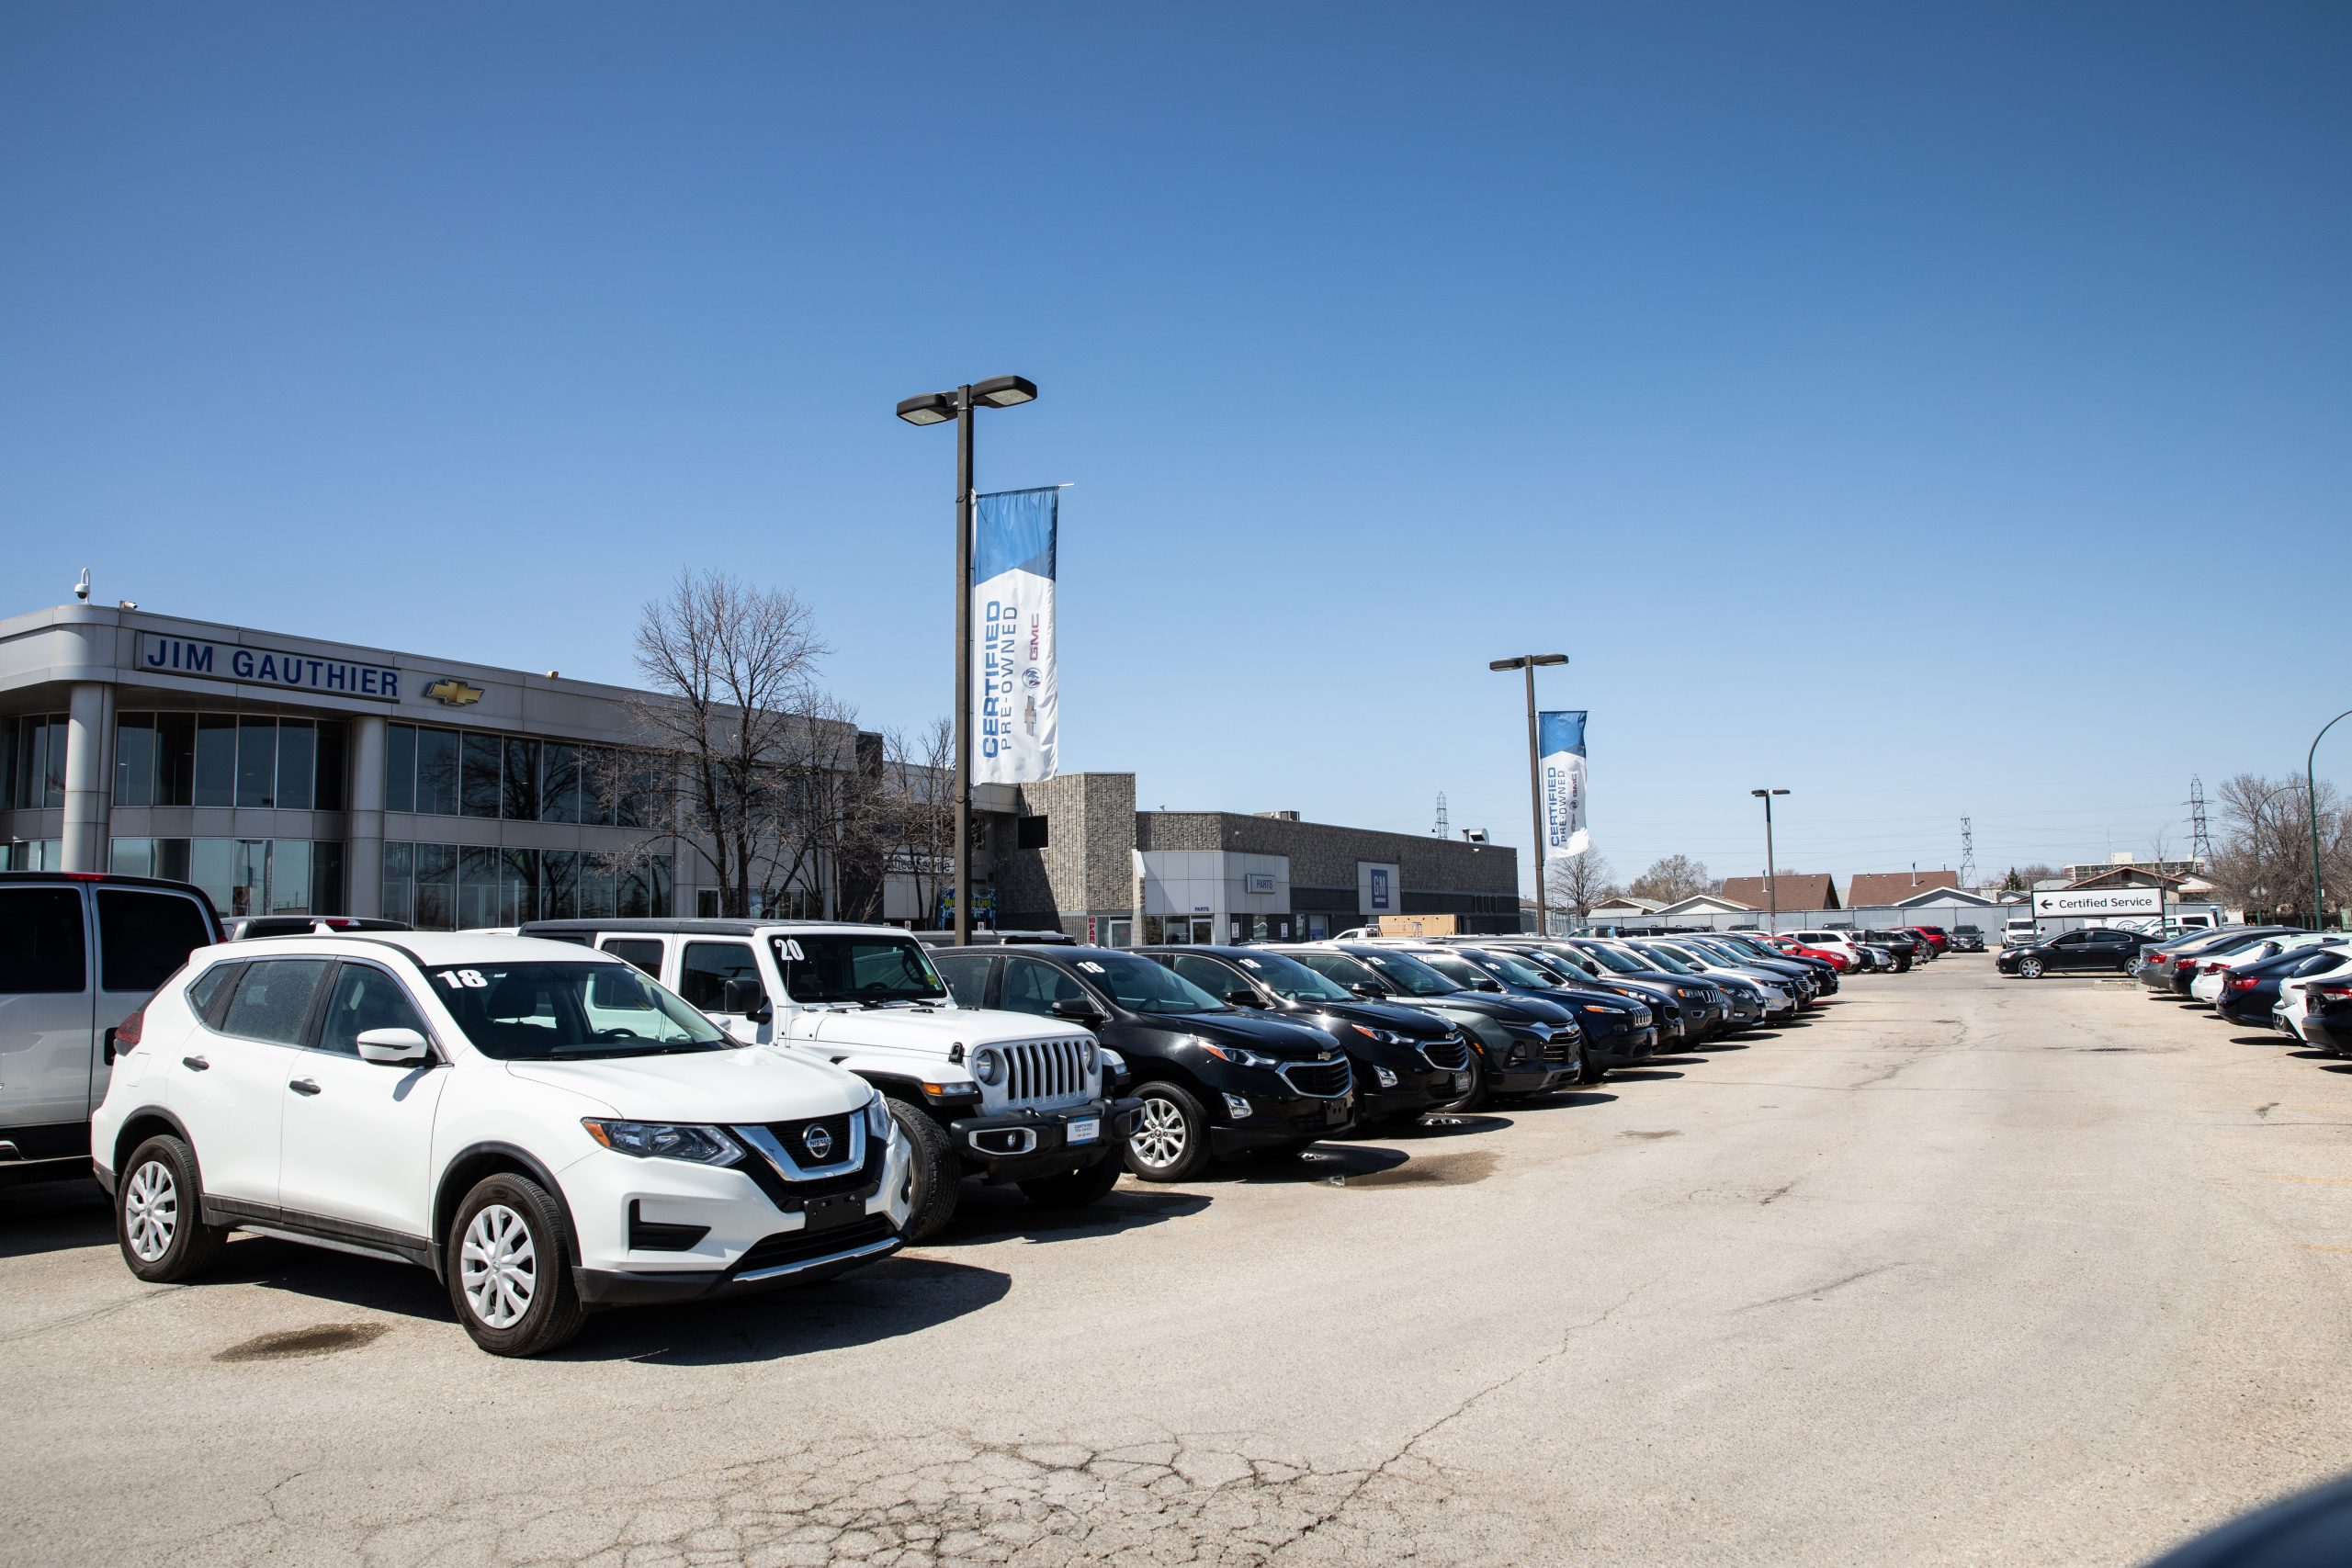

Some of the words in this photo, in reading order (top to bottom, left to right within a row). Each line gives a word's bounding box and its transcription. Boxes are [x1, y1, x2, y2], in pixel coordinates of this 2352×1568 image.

[1029, 613, 1039, 661] GMC
[147, 639, 214, 673] JIM
[232, 649, 399, 697] GAUTHIER
[982, 600, 1001, 759] CERTIFIED
[1001, 606, 1018, 750] PRE-OWNED
[1547, 767, 1560, 847] CERTIFIED
[1557, 771, 1567, 842] PRE-OWNED
[1256, 878, 1273, 890] PARTS
[1374, 875, 1386, 897] GM
[2059, 898, 2108, 908] Certified
[2110, 897, 2153, 908] Service
[774, 939, 805, 961] 20
[1076, 961, 1106, 974] 18
[436, 969, 488, 989] 18
